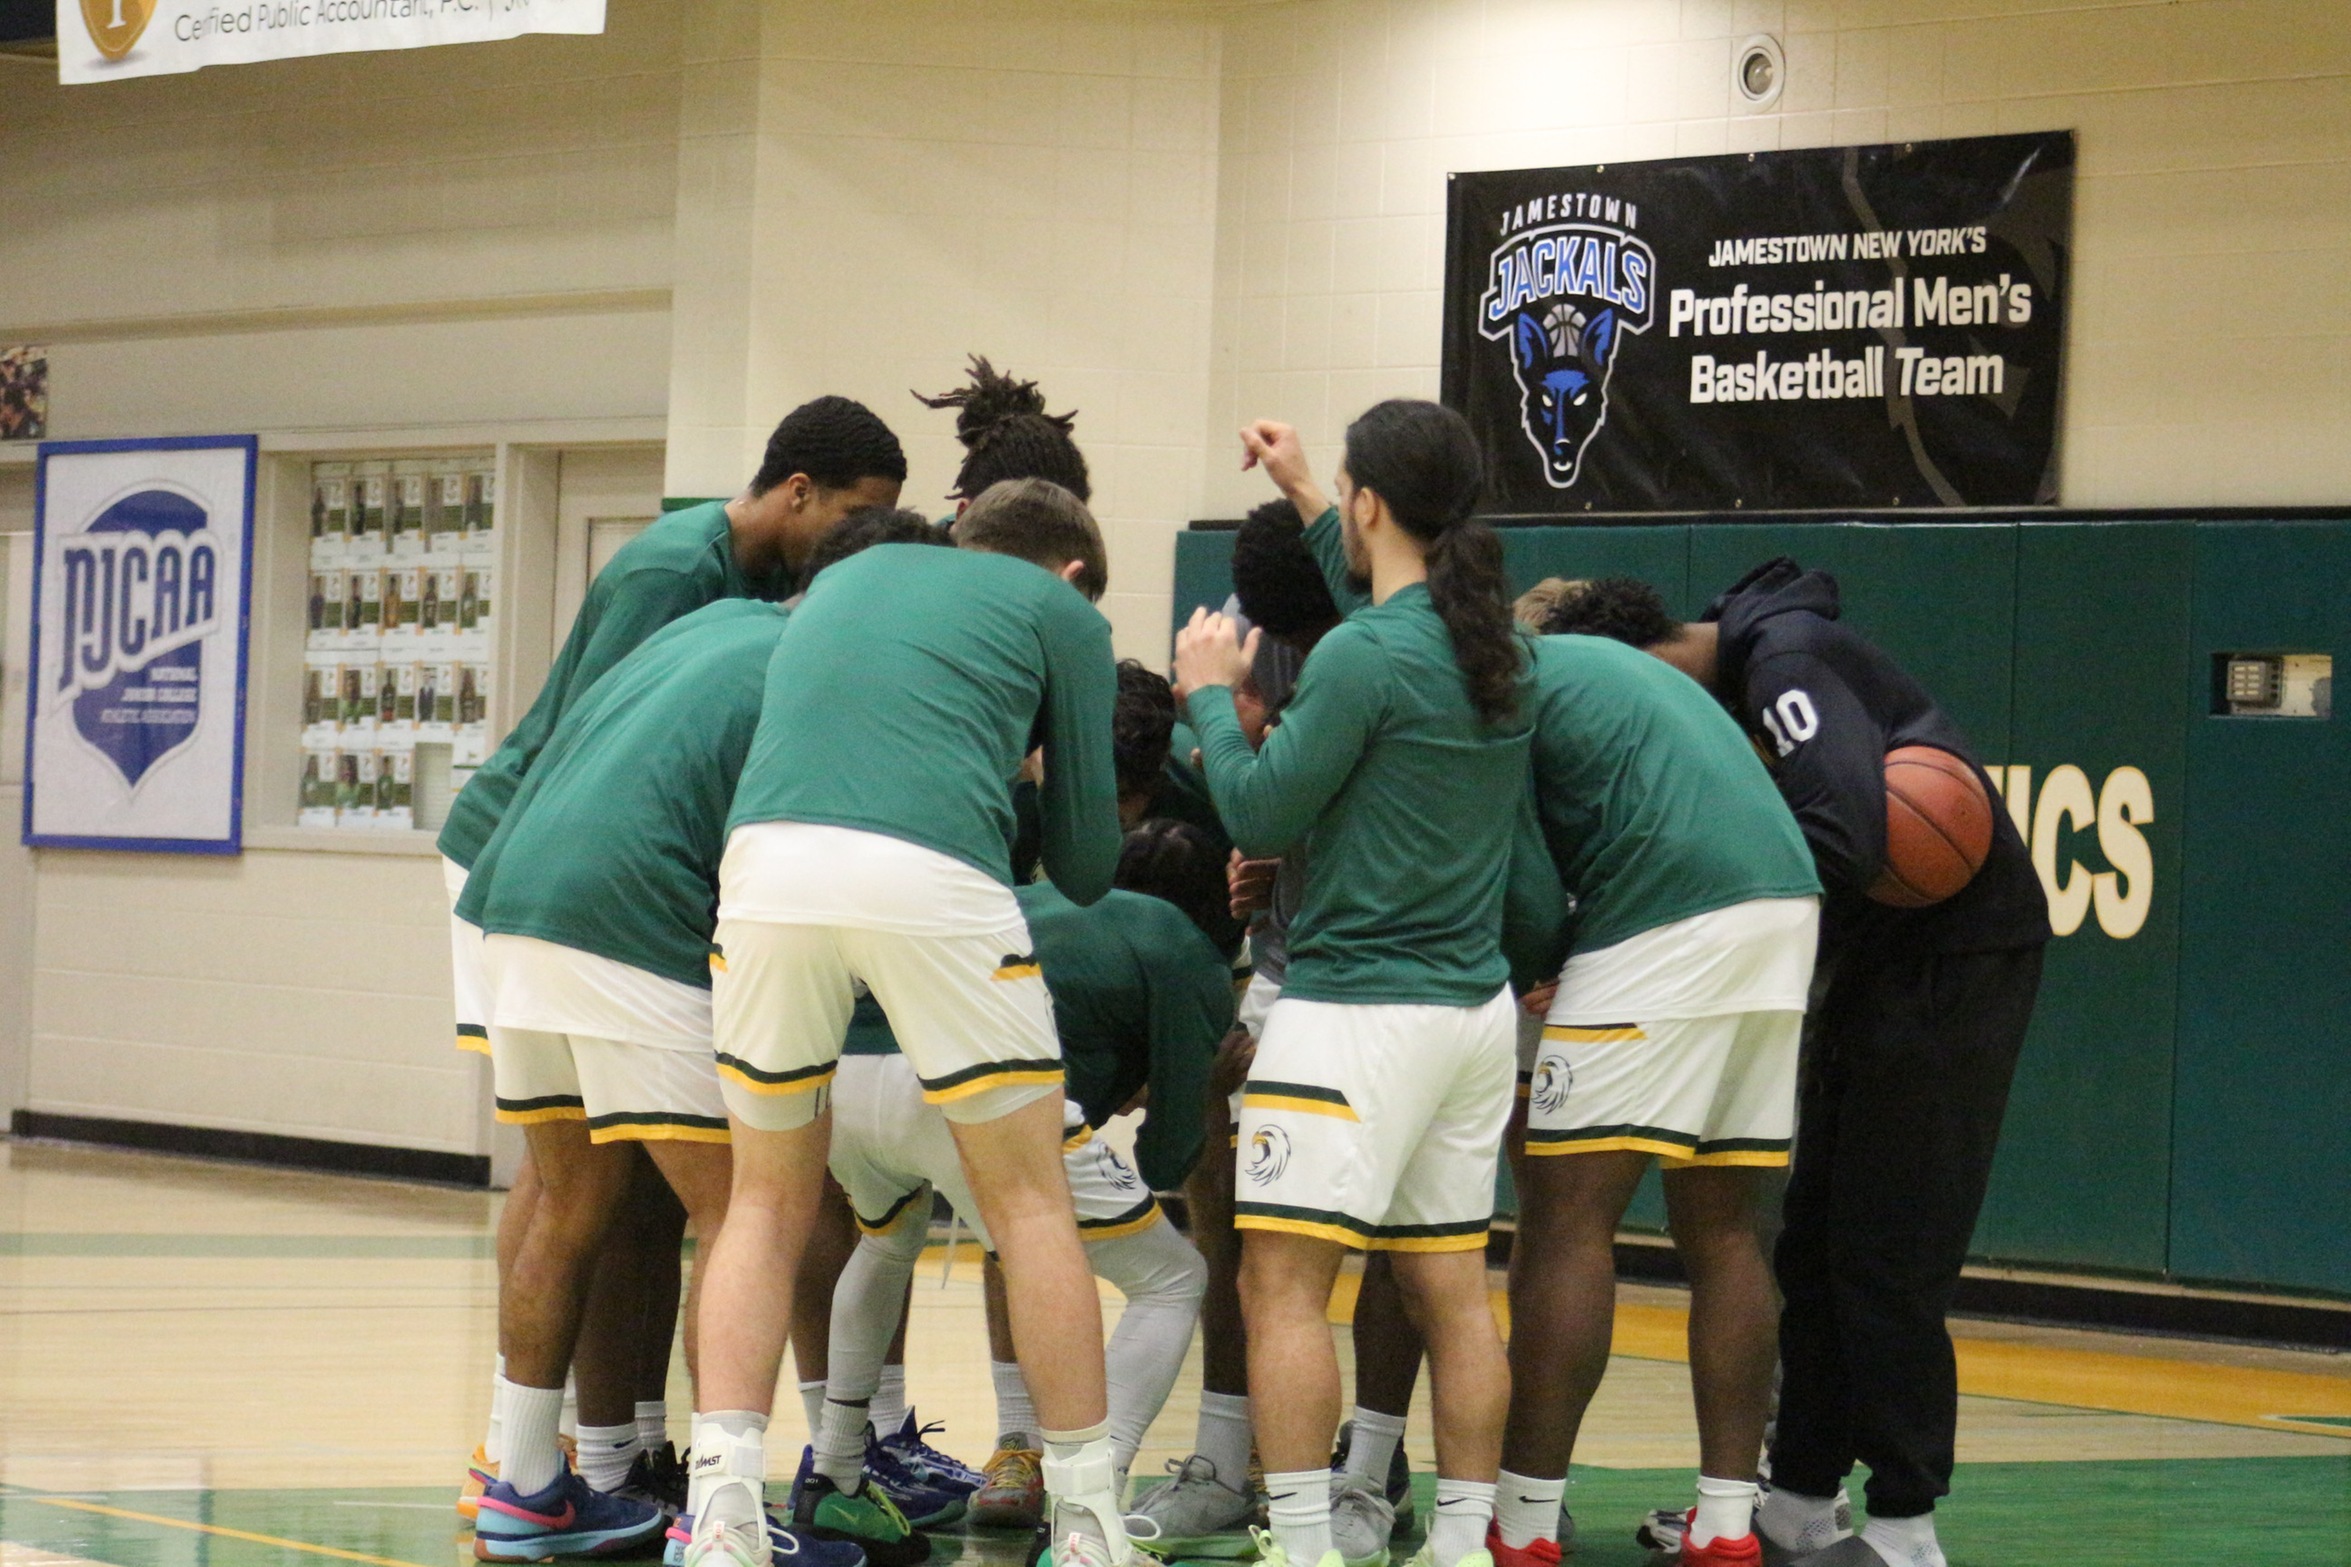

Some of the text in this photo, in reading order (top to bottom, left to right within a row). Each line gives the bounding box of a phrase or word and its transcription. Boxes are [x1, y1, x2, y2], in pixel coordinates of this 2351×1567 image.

[258, 2, 311, 31] Public
[1500, 193, 1637, 236] JAMESTOWN
[1488, 235, 1647, 321] JACKALS
[1708, 226, 1987, 268] JAMESTOWN NEW YORK'S
[1669, 273, 2033, 338] Professional Men's
[1690, 345, 2005, 404] Basketball Team
[57, 544, 216, 694] NJCAA
[1762, 688, 1819, 758] 10
